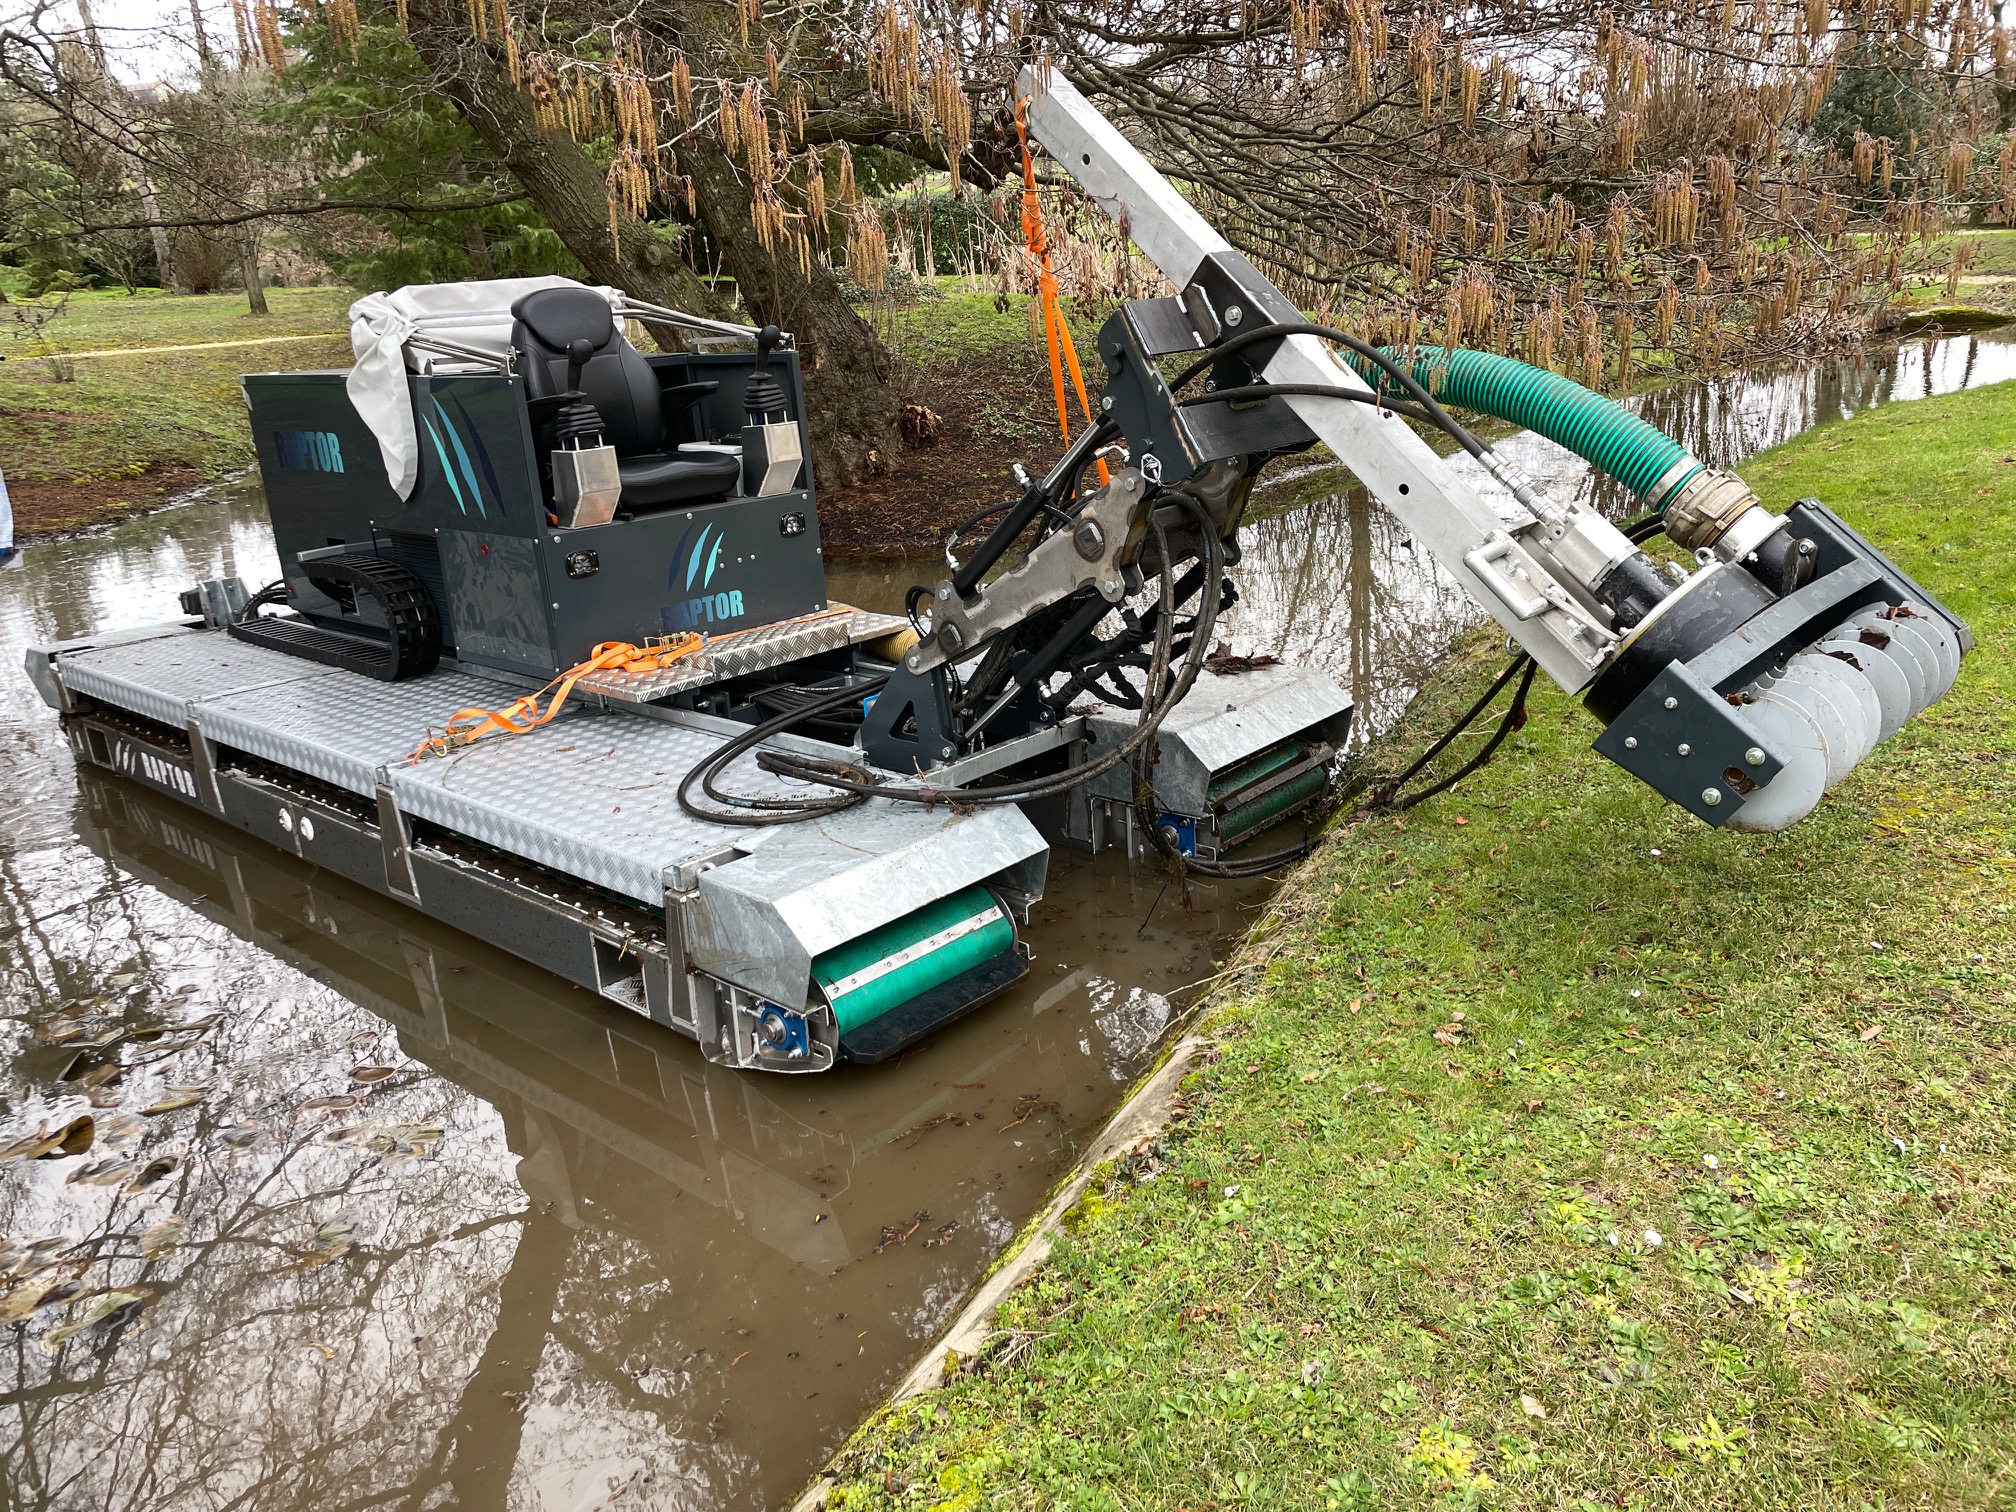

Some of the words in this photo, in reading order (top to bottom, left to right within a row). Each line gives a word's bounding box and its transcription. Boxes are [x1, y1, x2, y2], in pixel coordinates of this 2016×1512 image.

[273, 431, 345, 473] RAPTOR
[660, 589, 745, 634] RAPTOR
[141, 752, 197, 798] RAPTOR
